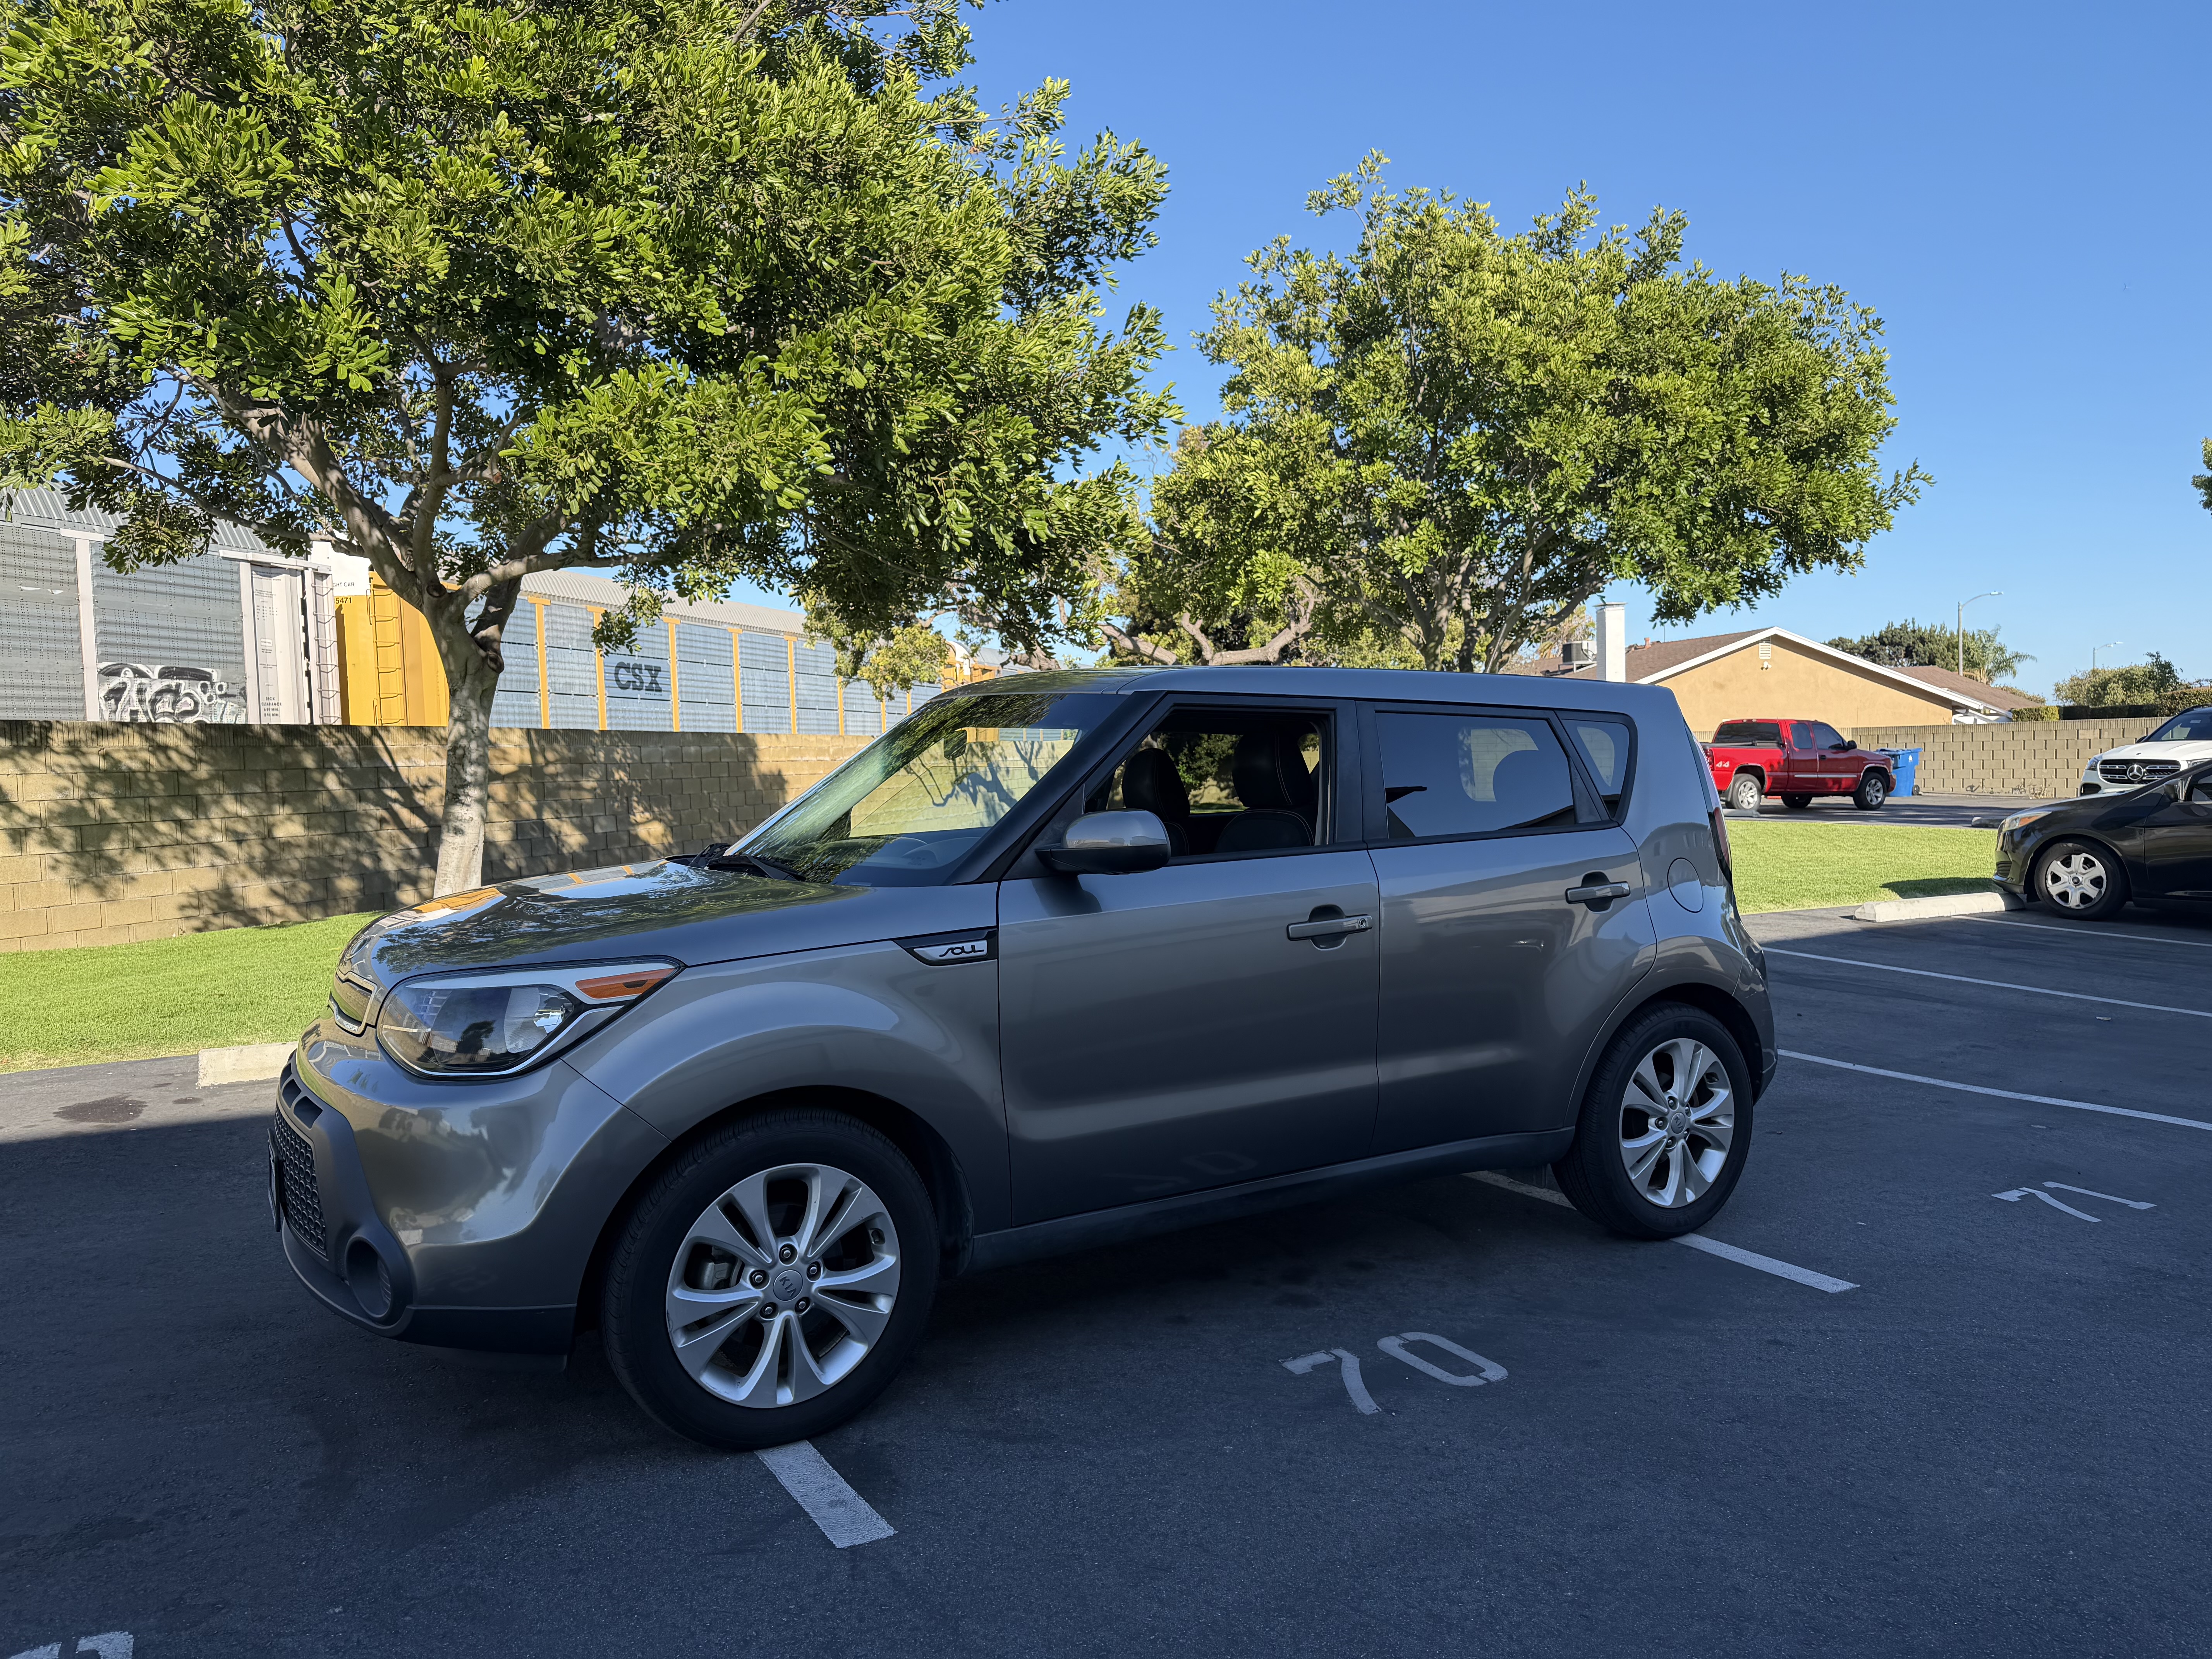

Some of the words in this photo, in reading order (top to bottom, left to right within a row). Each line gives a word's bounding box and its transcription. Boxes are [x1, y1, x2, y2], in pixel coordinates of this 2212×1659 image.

[614, 661, 662, 692] CSX
[939, 945, 984, 957] SOUL
[1674, 1115, 1683, 1130] KIA
[779, 1274, 797, 1297] KIA
[1279, 1332, 1509, 1415] 70
